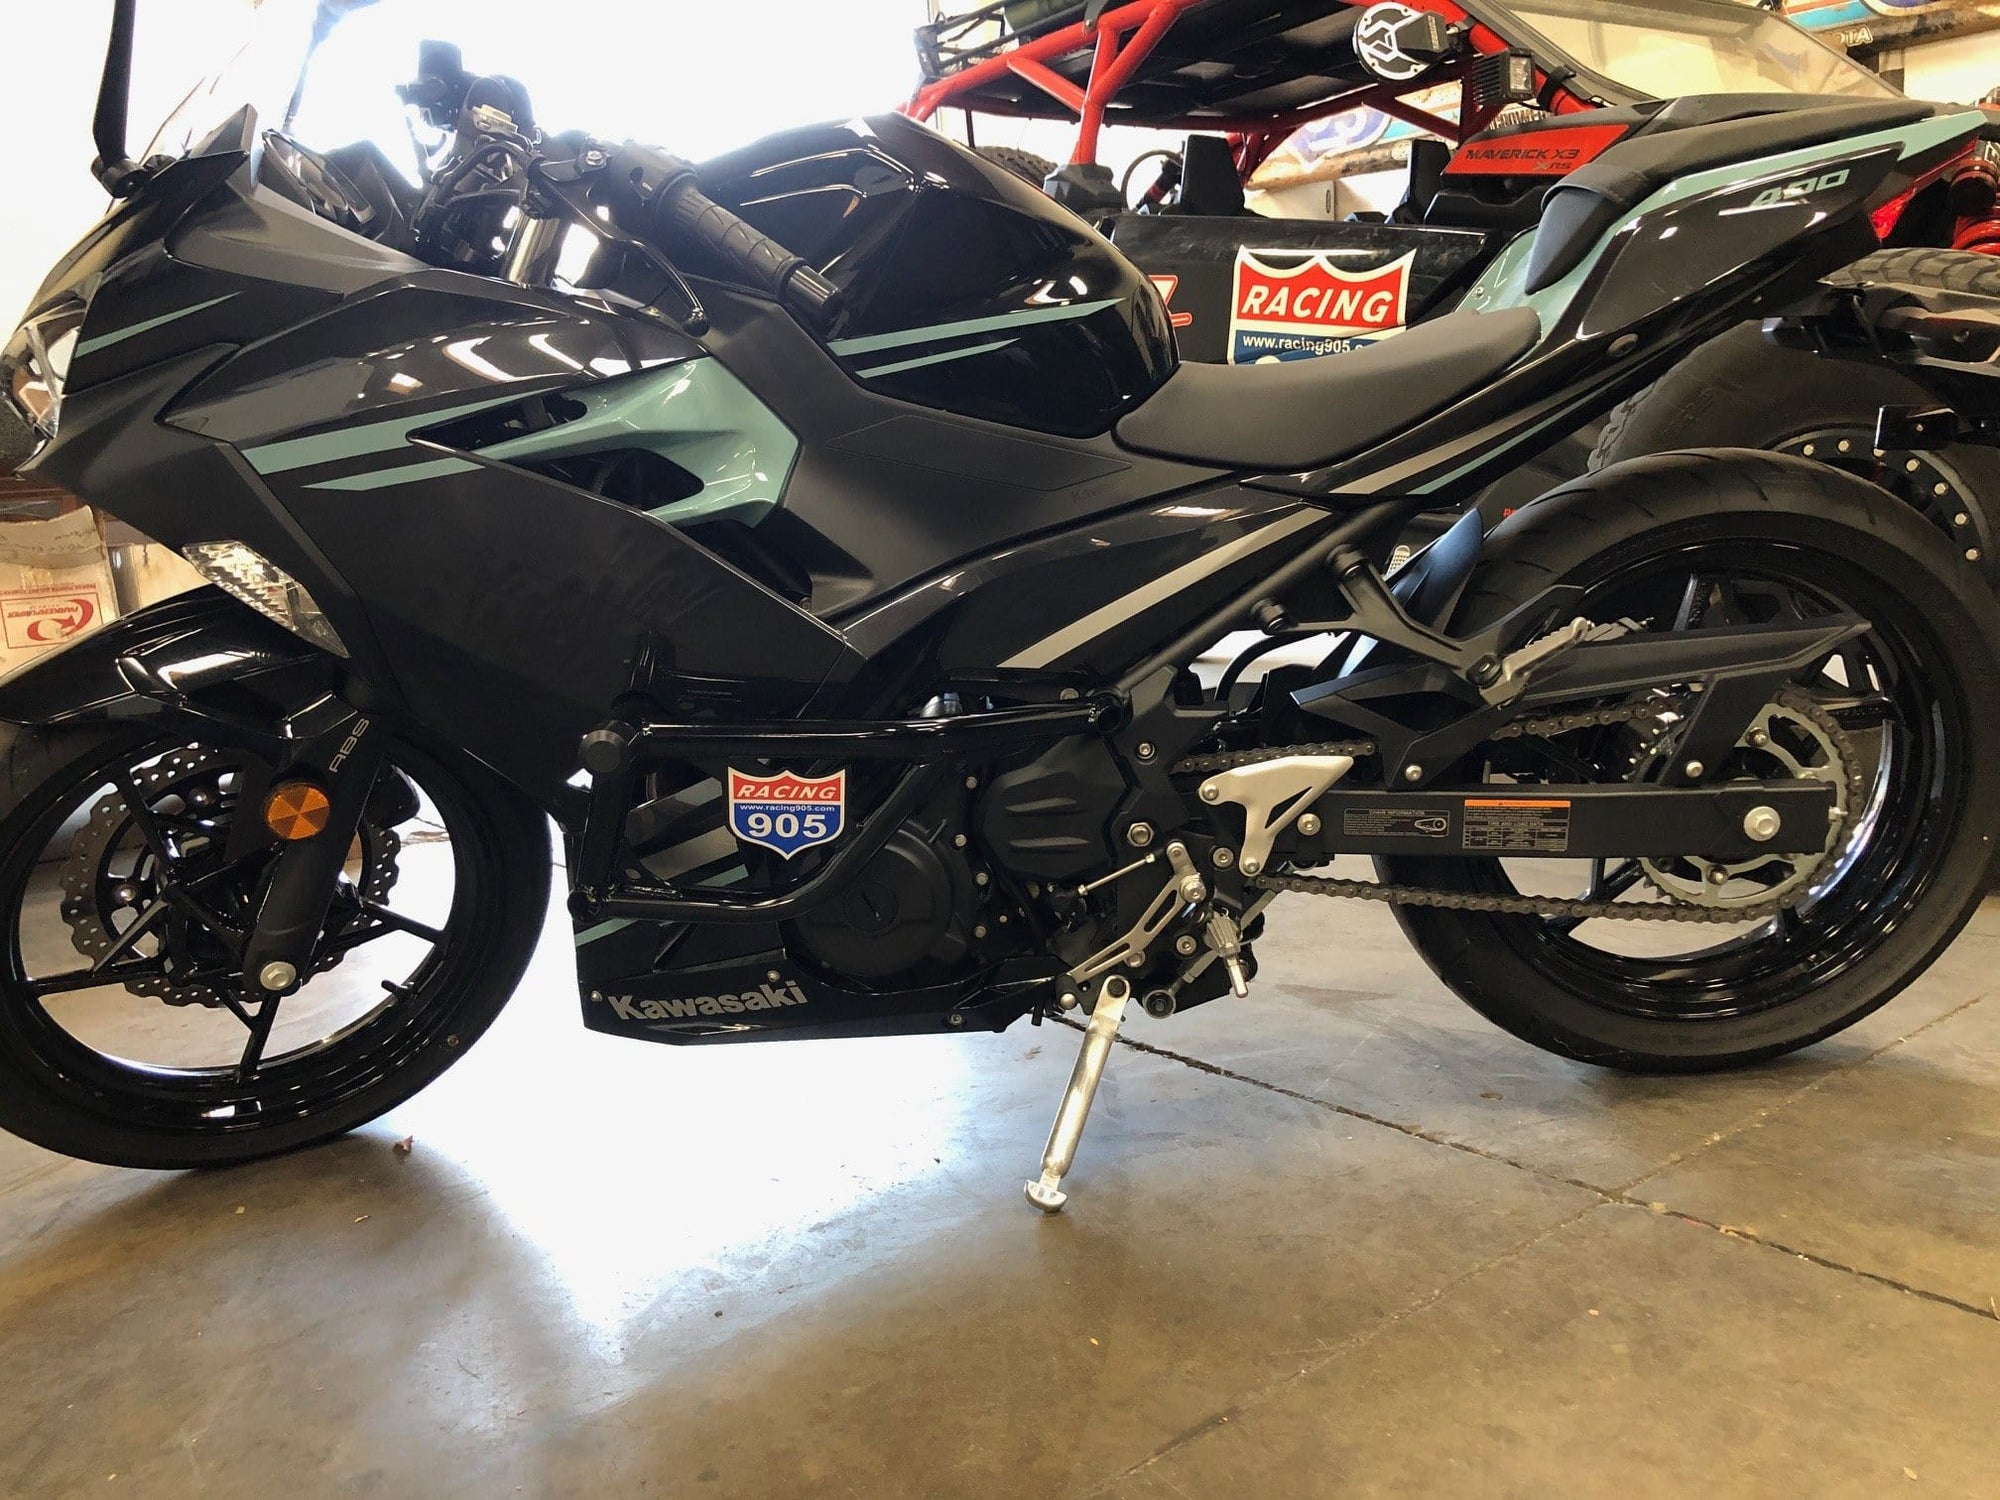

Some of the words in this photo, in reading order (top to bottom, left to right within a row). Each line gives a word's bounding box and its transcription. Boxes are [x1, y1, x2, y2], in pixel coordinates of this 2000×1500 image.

[1465, 149, 1549, 160] MAVERICK
[1551, 149, 1580, 159] X3
[1240, 284, 1394, 323] RACING
[328, 718, 370, 773] ABS
[736, 784, 838, 800] RACING
[740, 805, 835, 813] www.racing905.com
[747, 812, 827, 838] 905
[608, 980, 809, 1020] Kawasaki
